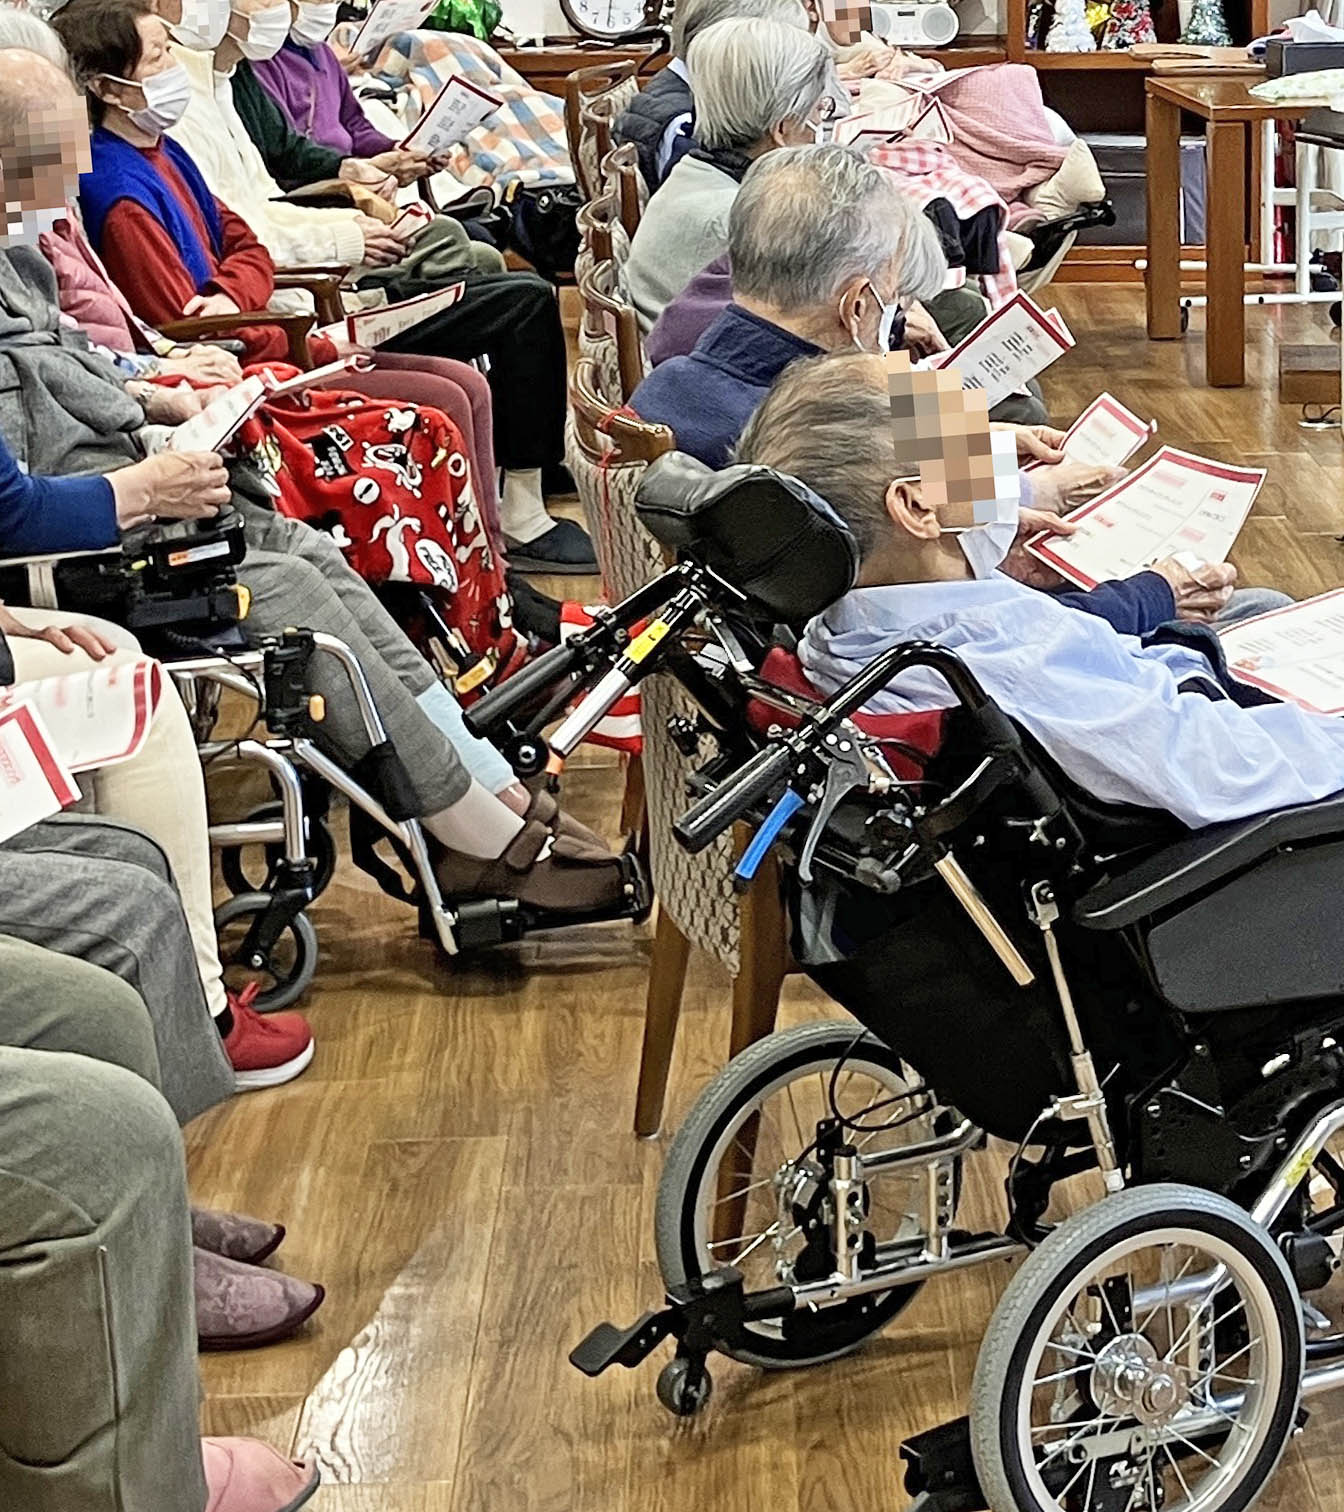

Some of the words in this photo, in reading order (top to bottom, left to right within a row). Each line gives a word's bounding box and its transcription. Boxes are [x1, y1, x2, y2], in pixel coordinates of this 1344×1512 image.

[580, 1, 588, 12] 8
[635, 2, 641, 13] 4
[592, 12, 599, 24] 7
[607, 16, 615, 28] 6
[623, 12, 631, 25] 5
